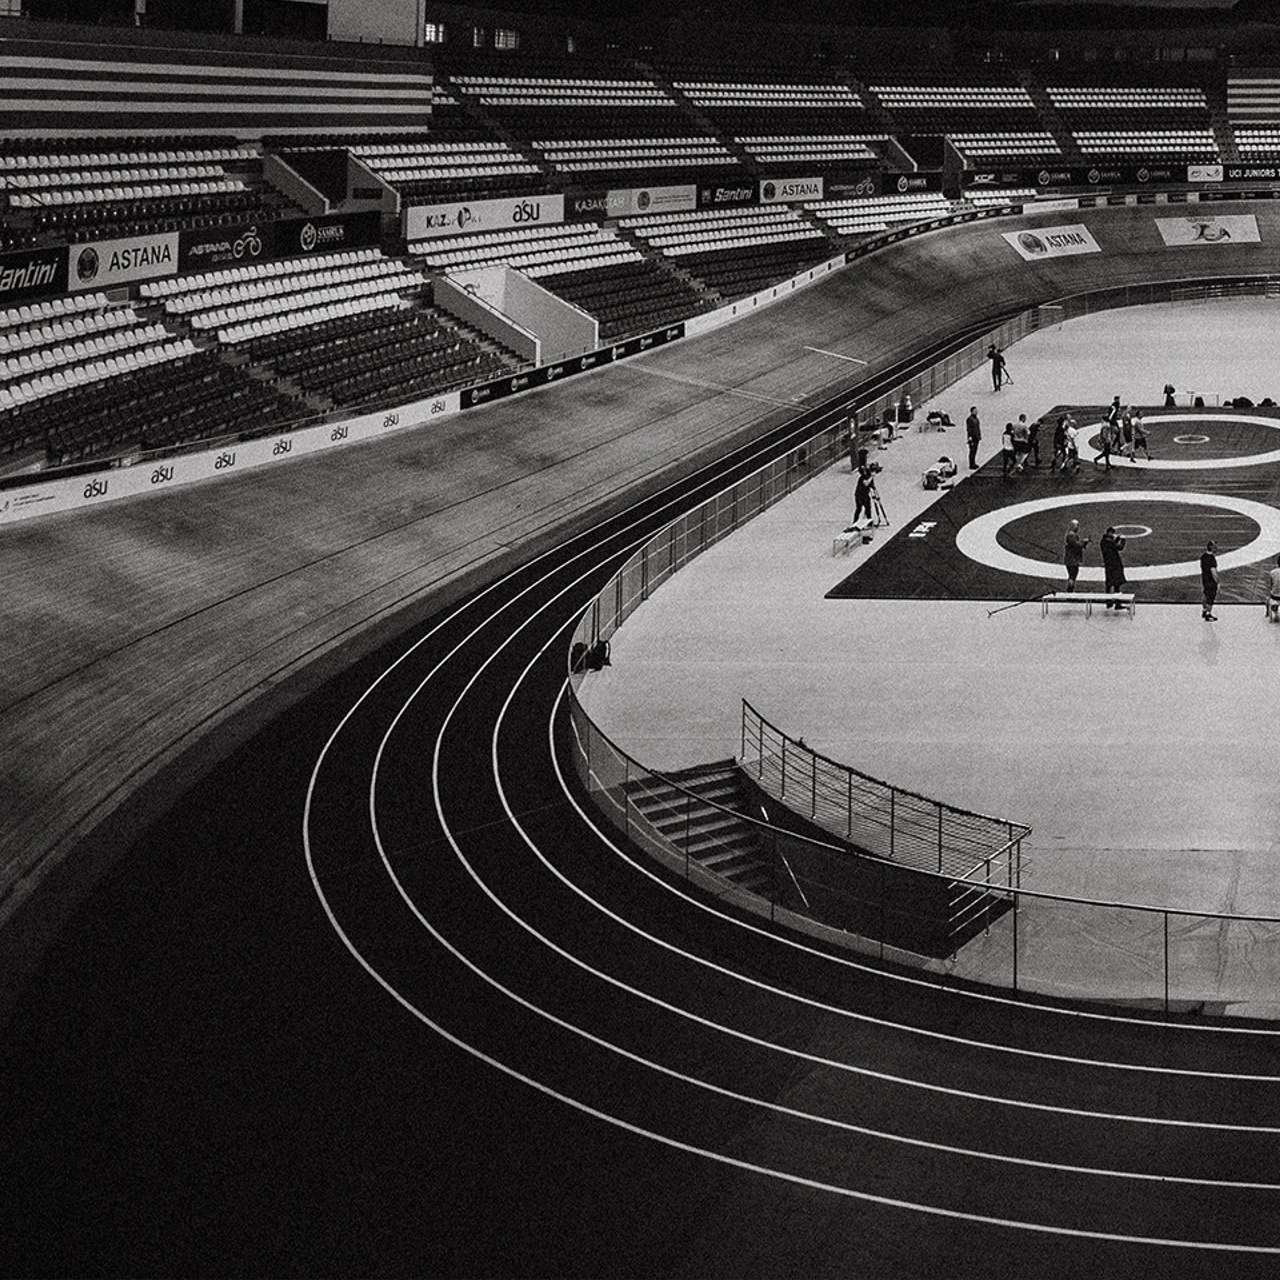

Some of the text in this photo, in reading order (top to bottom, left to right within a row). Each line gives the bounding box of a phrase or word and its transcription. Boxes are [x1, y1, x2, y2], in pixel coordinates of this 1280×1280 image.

[1229, 169, 1241, 178] UCI
[1243, 169, 1276, 178] JUNIORS
[714, 185, 754, 203] Santini
[781, 183, 820, 197] ASTANA
[1044, 232, 1087, 249] ASTANA
[108, 244, 172, 272] ASTANA
